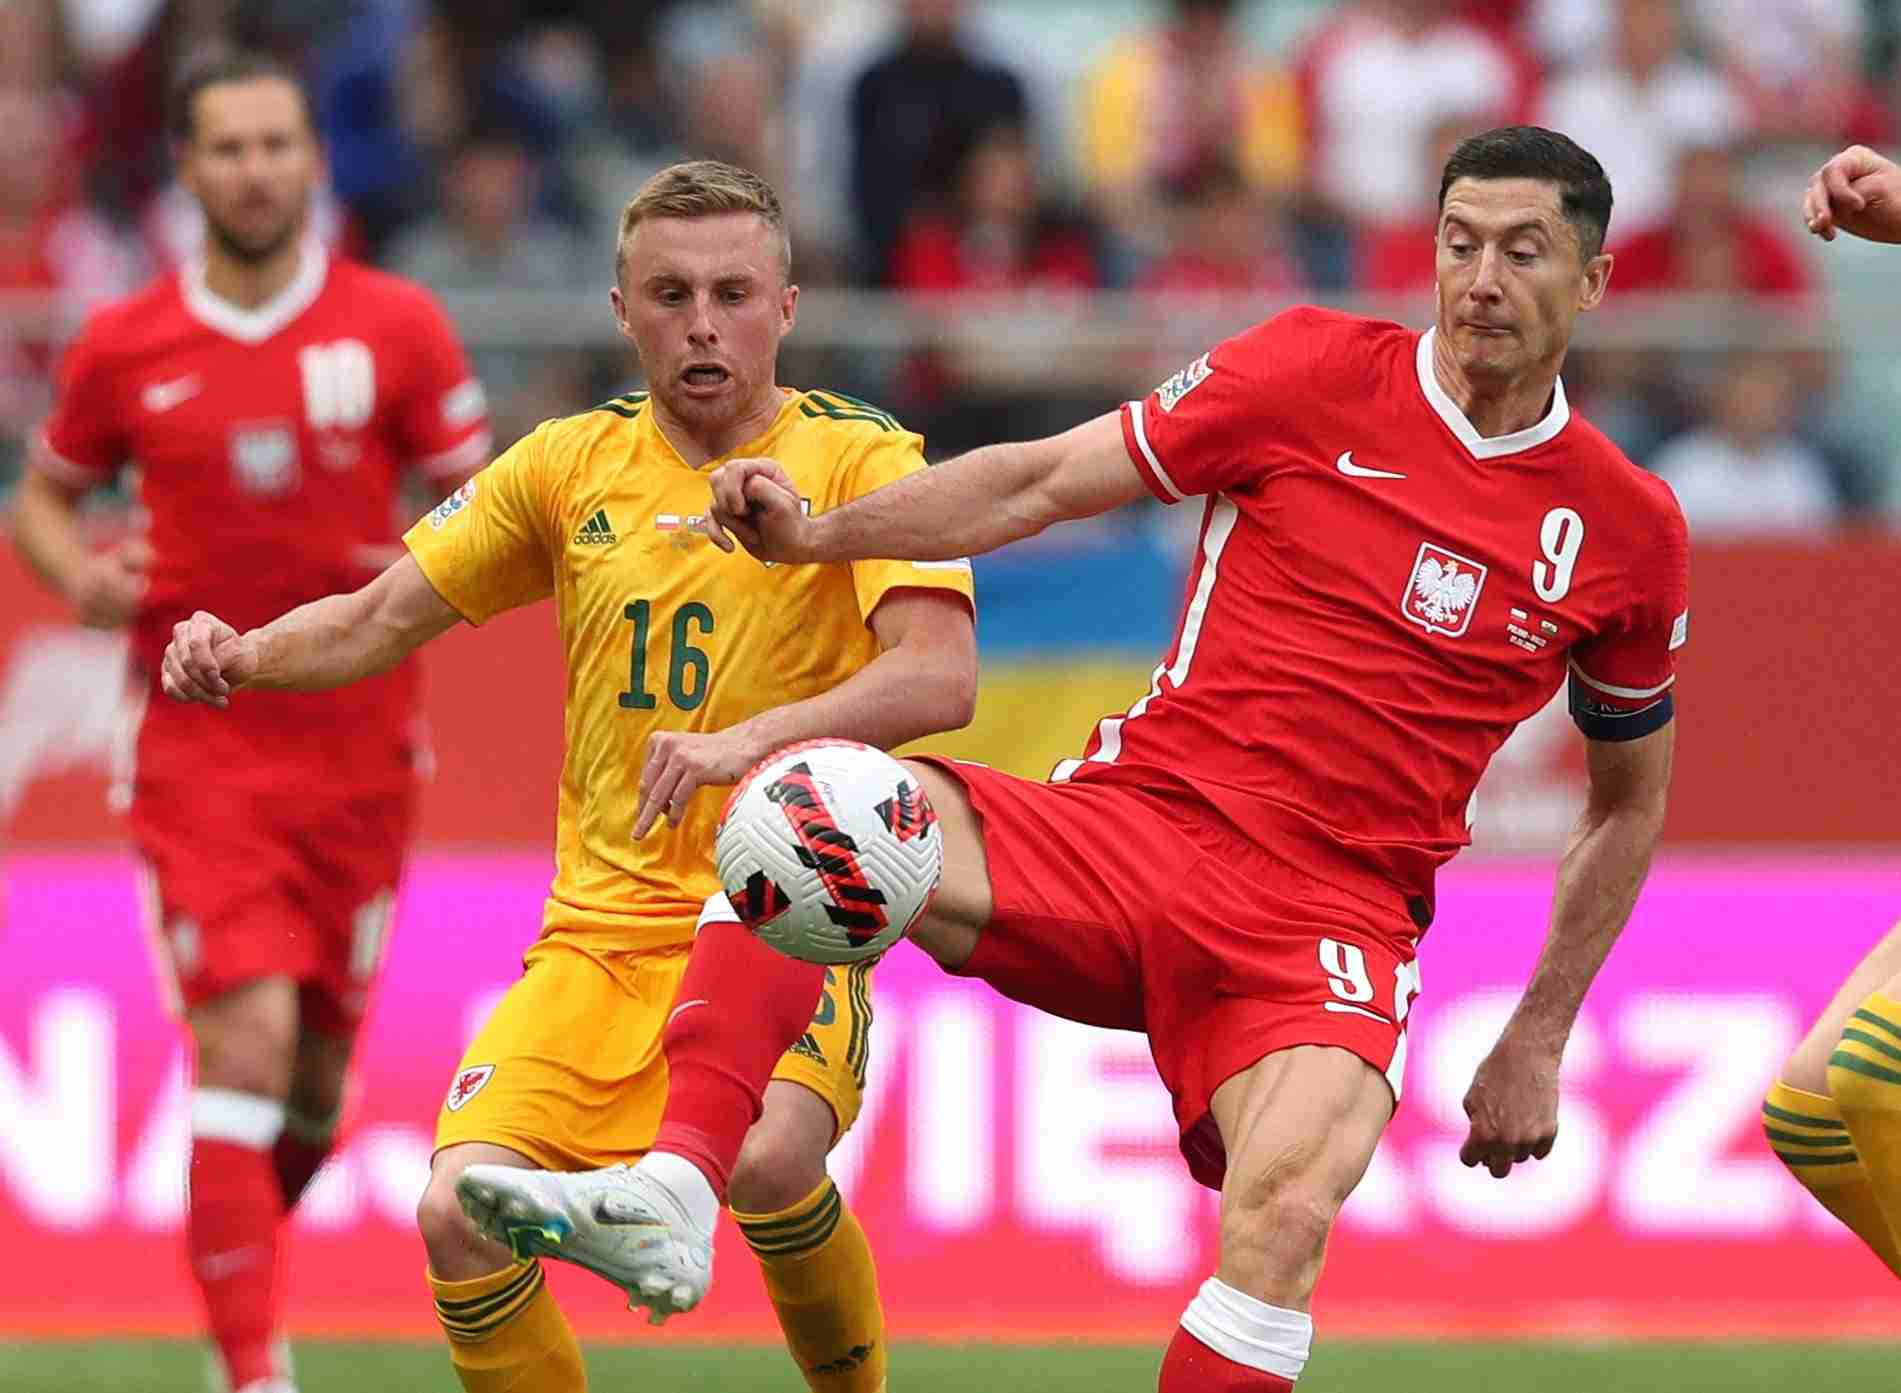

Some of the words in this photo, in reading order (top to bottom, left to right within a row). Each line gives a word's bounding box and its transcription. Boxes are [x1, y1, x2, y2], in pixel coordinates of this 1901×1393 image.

[573, 531, 617, 545] adidas
[1532, 506, 1585, 603] 9
[617, 598, 715, 711] 16
[1318, 937, 1376, 1003] 9
